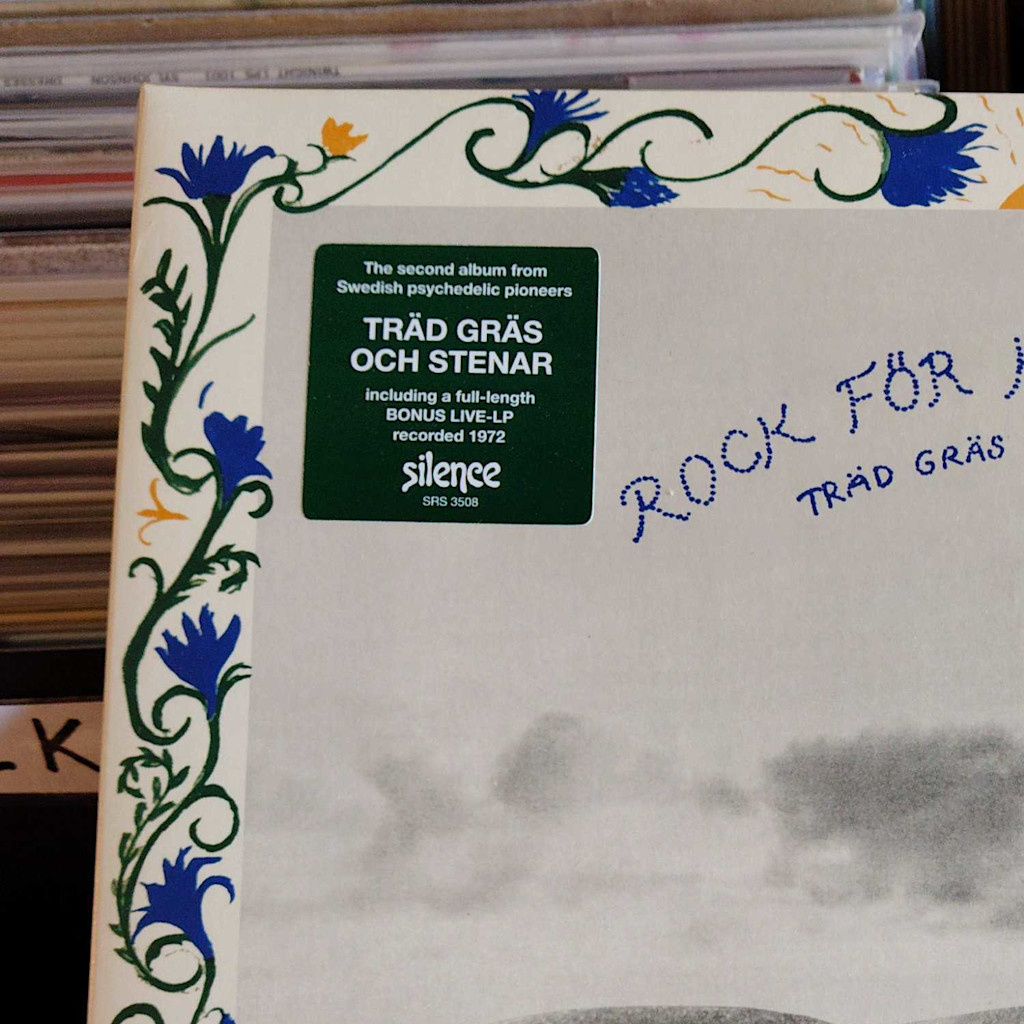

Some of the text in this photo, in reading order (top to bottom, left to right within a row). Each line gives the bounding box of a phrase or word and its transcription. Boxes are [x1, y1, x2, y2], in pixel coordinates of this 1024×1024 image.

[363, 261, 548, 278] The second album from
[336, 279, 573, 299] Swedish psychedelic pioneers
[363, 311, 544, 344] TRÄD GRÄS
[350, 347, 554, 376] OCH STENAR
[364, 388, 536, 407] including a full-length
[385, 408, 515, 424] BONUS LIVE-LP
[392, 428, 506, 444] recorded 1972
[620, 403, 817, 544] ROCK
[836, 350, 974, 434] FÖR
[401, 450, 502, 494] silence
[797, 465, 894, 516] TRÄD
[915, 434, 1005, 475] GRÄS
[422, 495, 479, 508] SRS 3508
[0, 717, 101, 773] K
